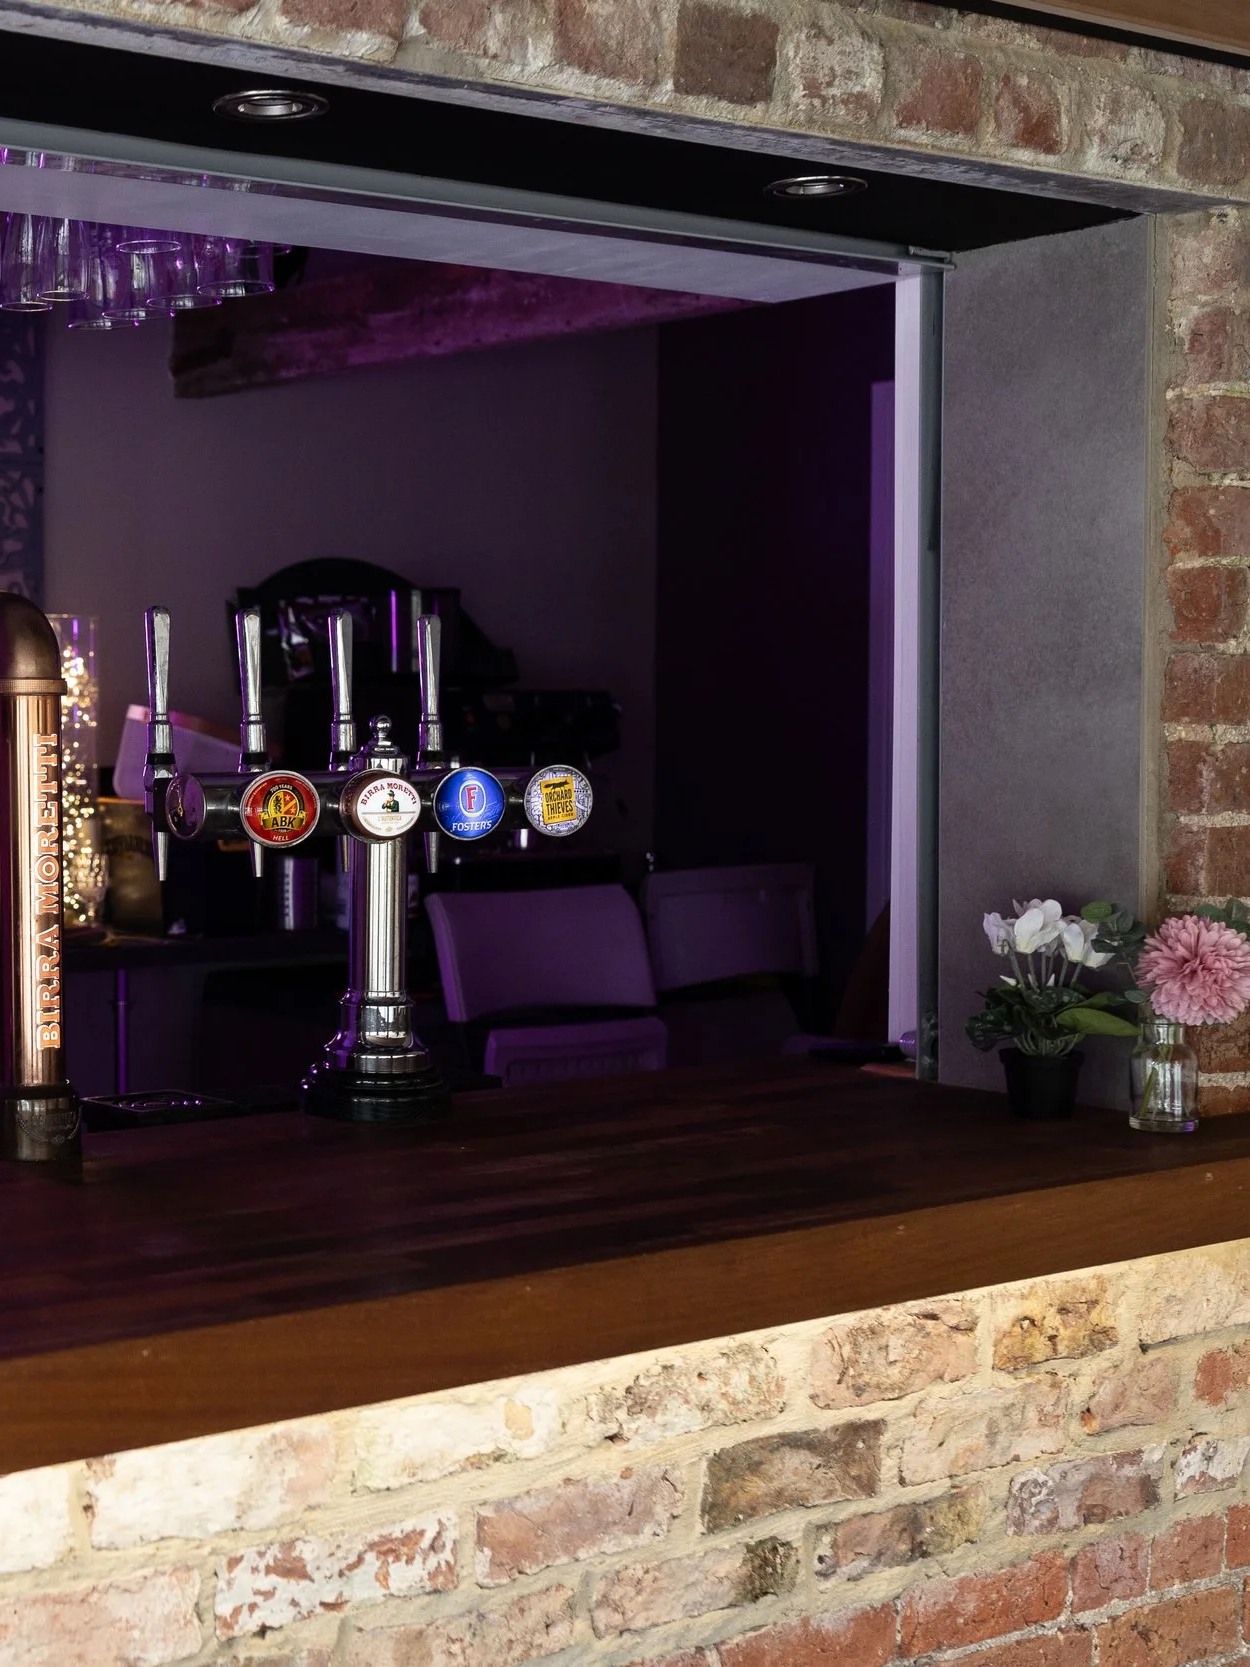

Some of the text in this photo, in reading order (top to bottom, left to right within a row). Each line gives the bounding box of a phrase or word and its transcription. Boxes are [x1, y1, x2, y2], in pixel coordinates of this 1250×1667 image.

[360, 782, 417, 806] BIRRA MORETTI
[466, 786, 478, 811] F
[545, 789, 573, 803] ORCHARD
[546, 800, 574, 816] THIEVES
[271, 816, 296, 829] ABK
[452, 820, 492, 832] FOSTER'S
[33, 733, 61, 1050] BIRRA MORETTI
